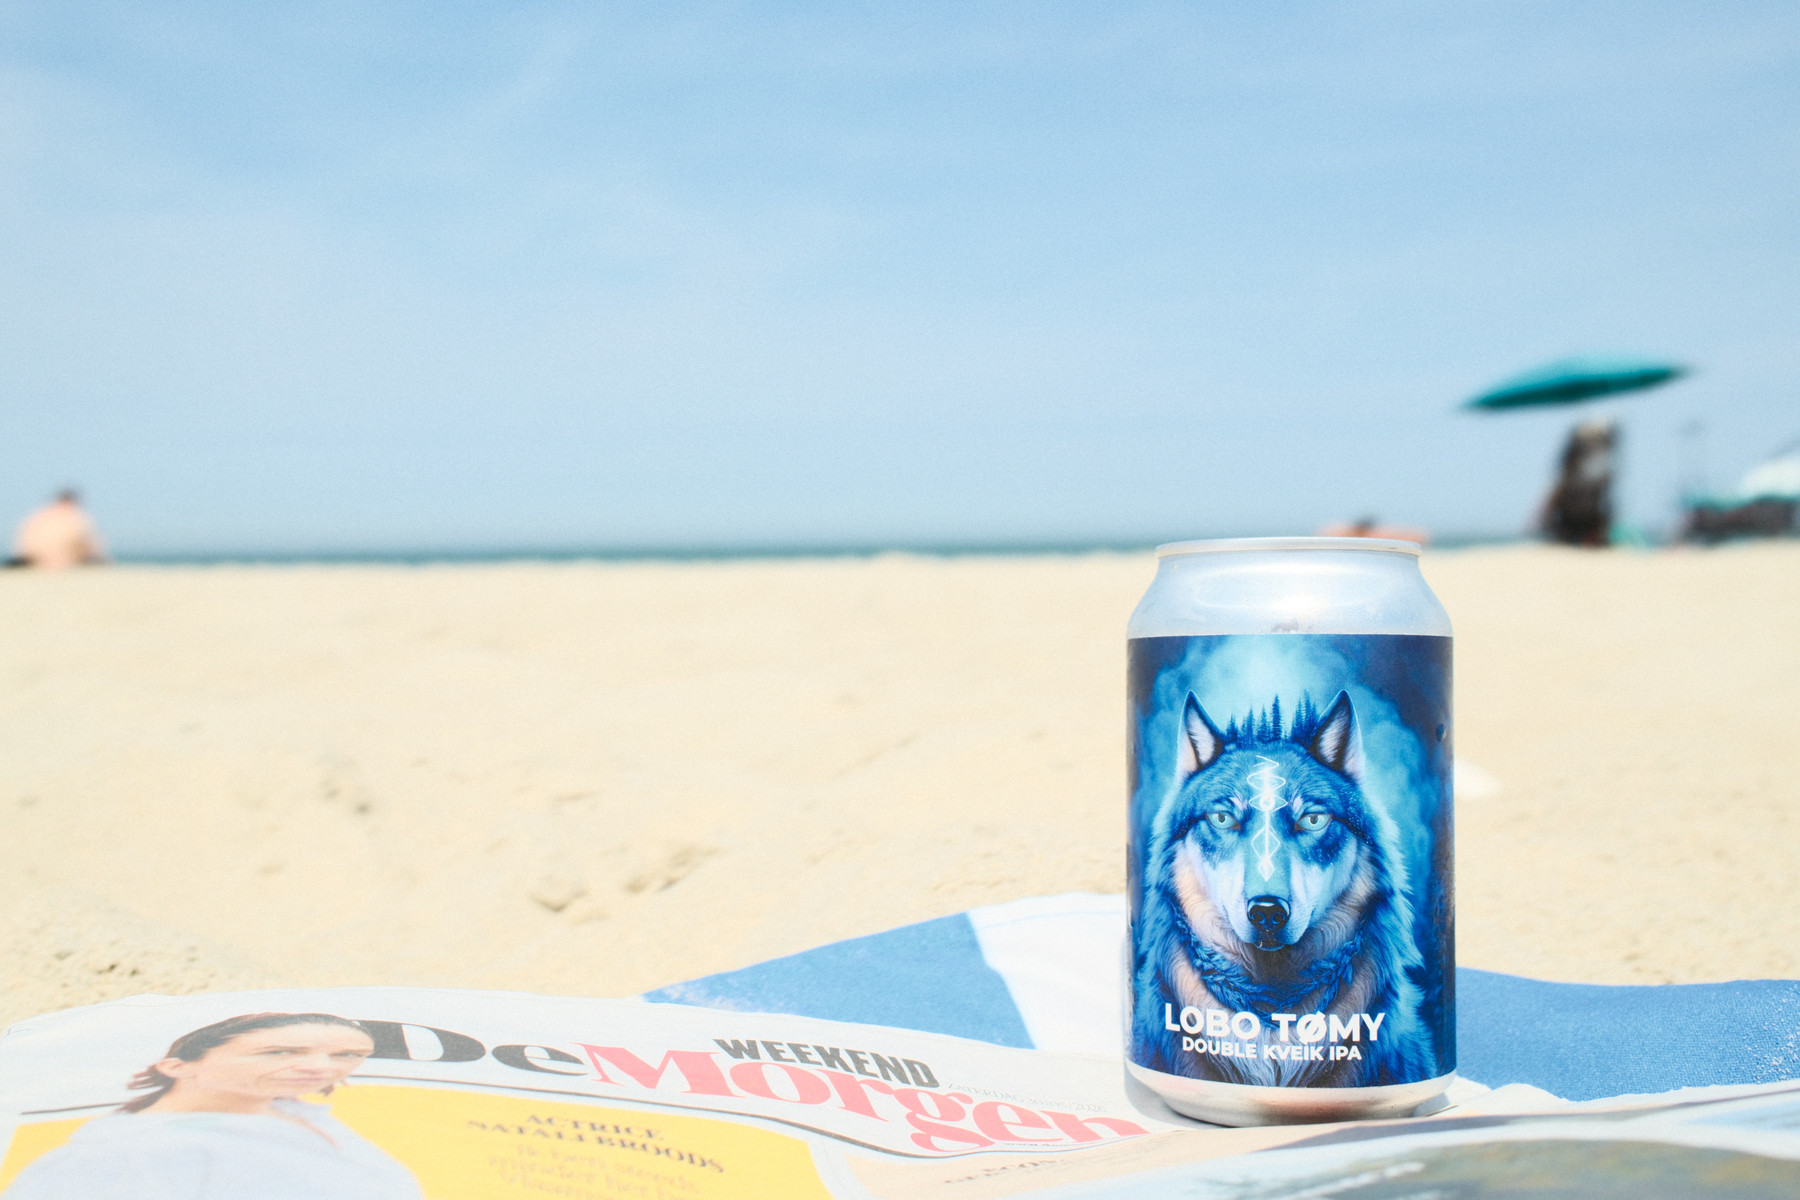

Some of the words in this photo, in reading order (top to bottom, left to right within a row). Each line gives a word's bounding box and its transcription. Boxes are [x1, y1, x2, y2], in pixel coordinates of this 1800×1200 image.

[1165, 1003, 1261, 1040] LOBO
[1271, 1011, 1385, 1045] TØMY
[713, 1038, 940, 1088] WEEKEND
[1182, 1036, 1258, 1059] DOUBLE
[1263, 1046, 1325, 1061] KVEIK
[1329, 1045, 1362, 1061] IPA
[570, 1041, 1151, 1153] Morgen
[527, 1114, 665, 1142] ACTRICE
[596, 1136, 725, 1173] BROODS
